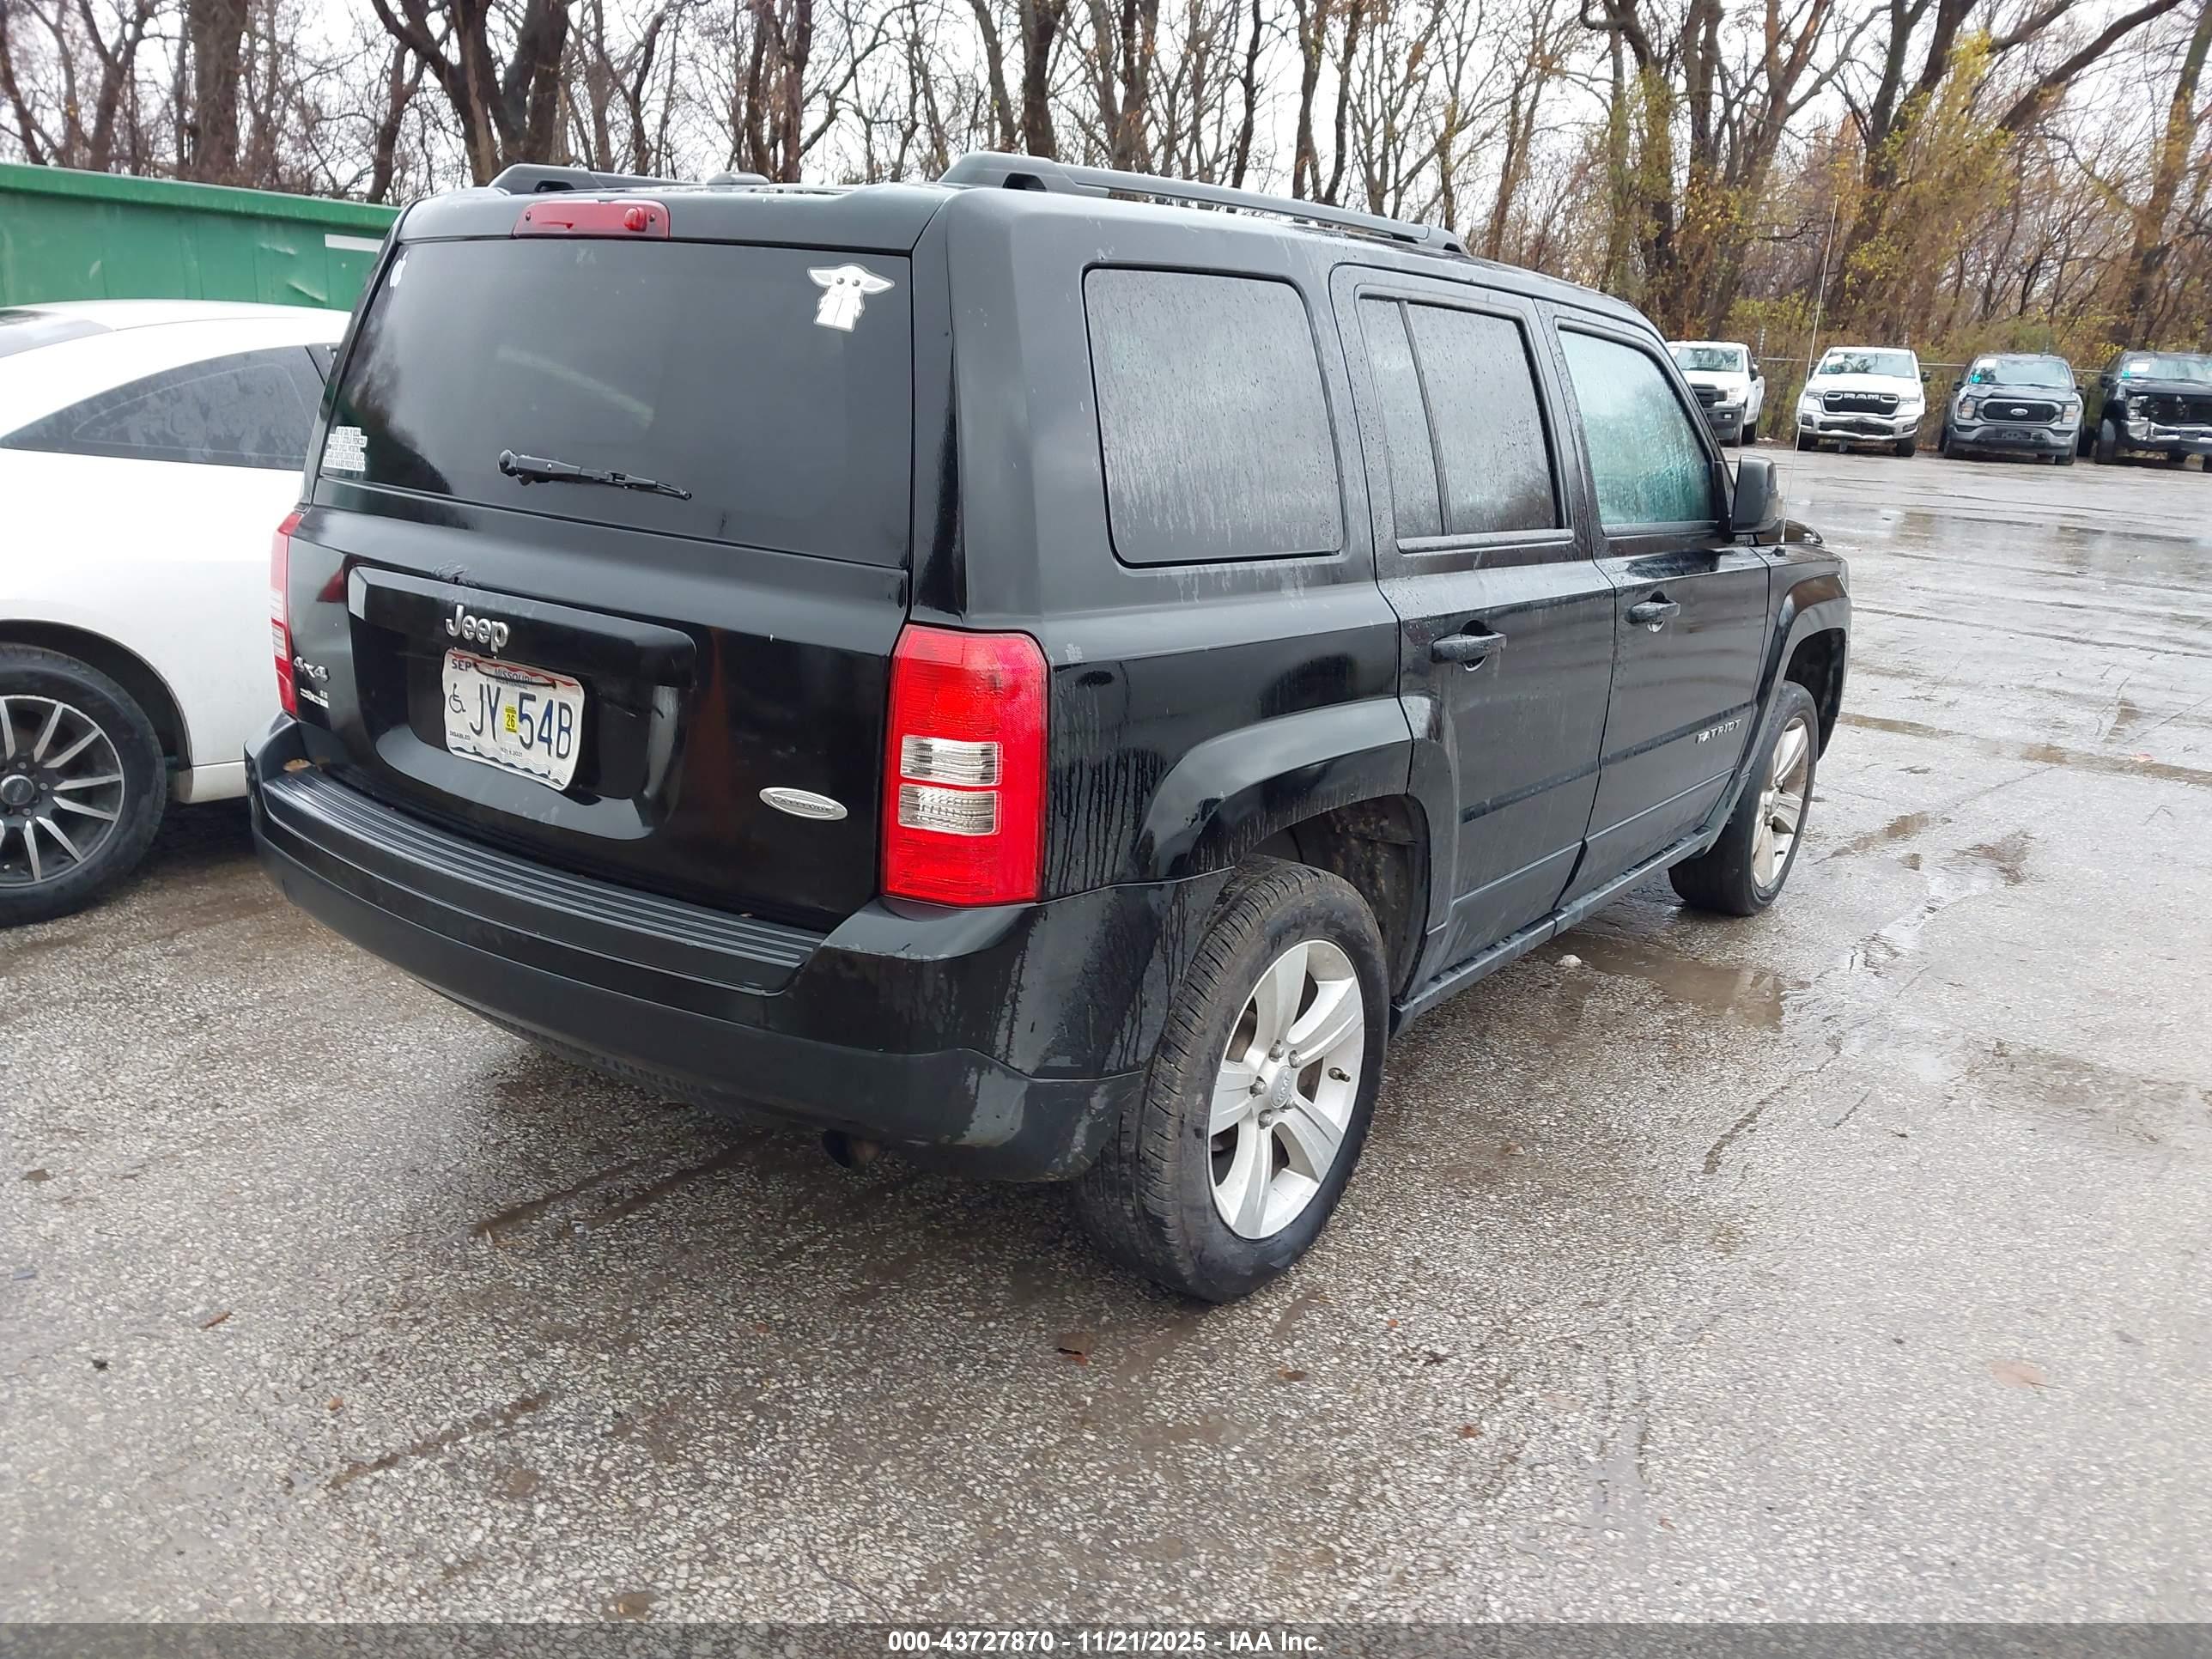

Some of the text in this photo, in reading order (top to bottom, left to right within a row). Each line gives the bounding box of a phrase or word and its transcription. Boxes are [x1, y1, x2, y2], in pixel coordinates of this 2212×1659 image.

[1843, 392, 1881, 401] RAM
[445, 604, 510, 653] Jeep
[451, 658, 472, 672] SEP
[469, 683, 574, 761] JY 54B
[506, 714, 516, 728] 26
[1698, 718, 1743, 744] PATRIOT
